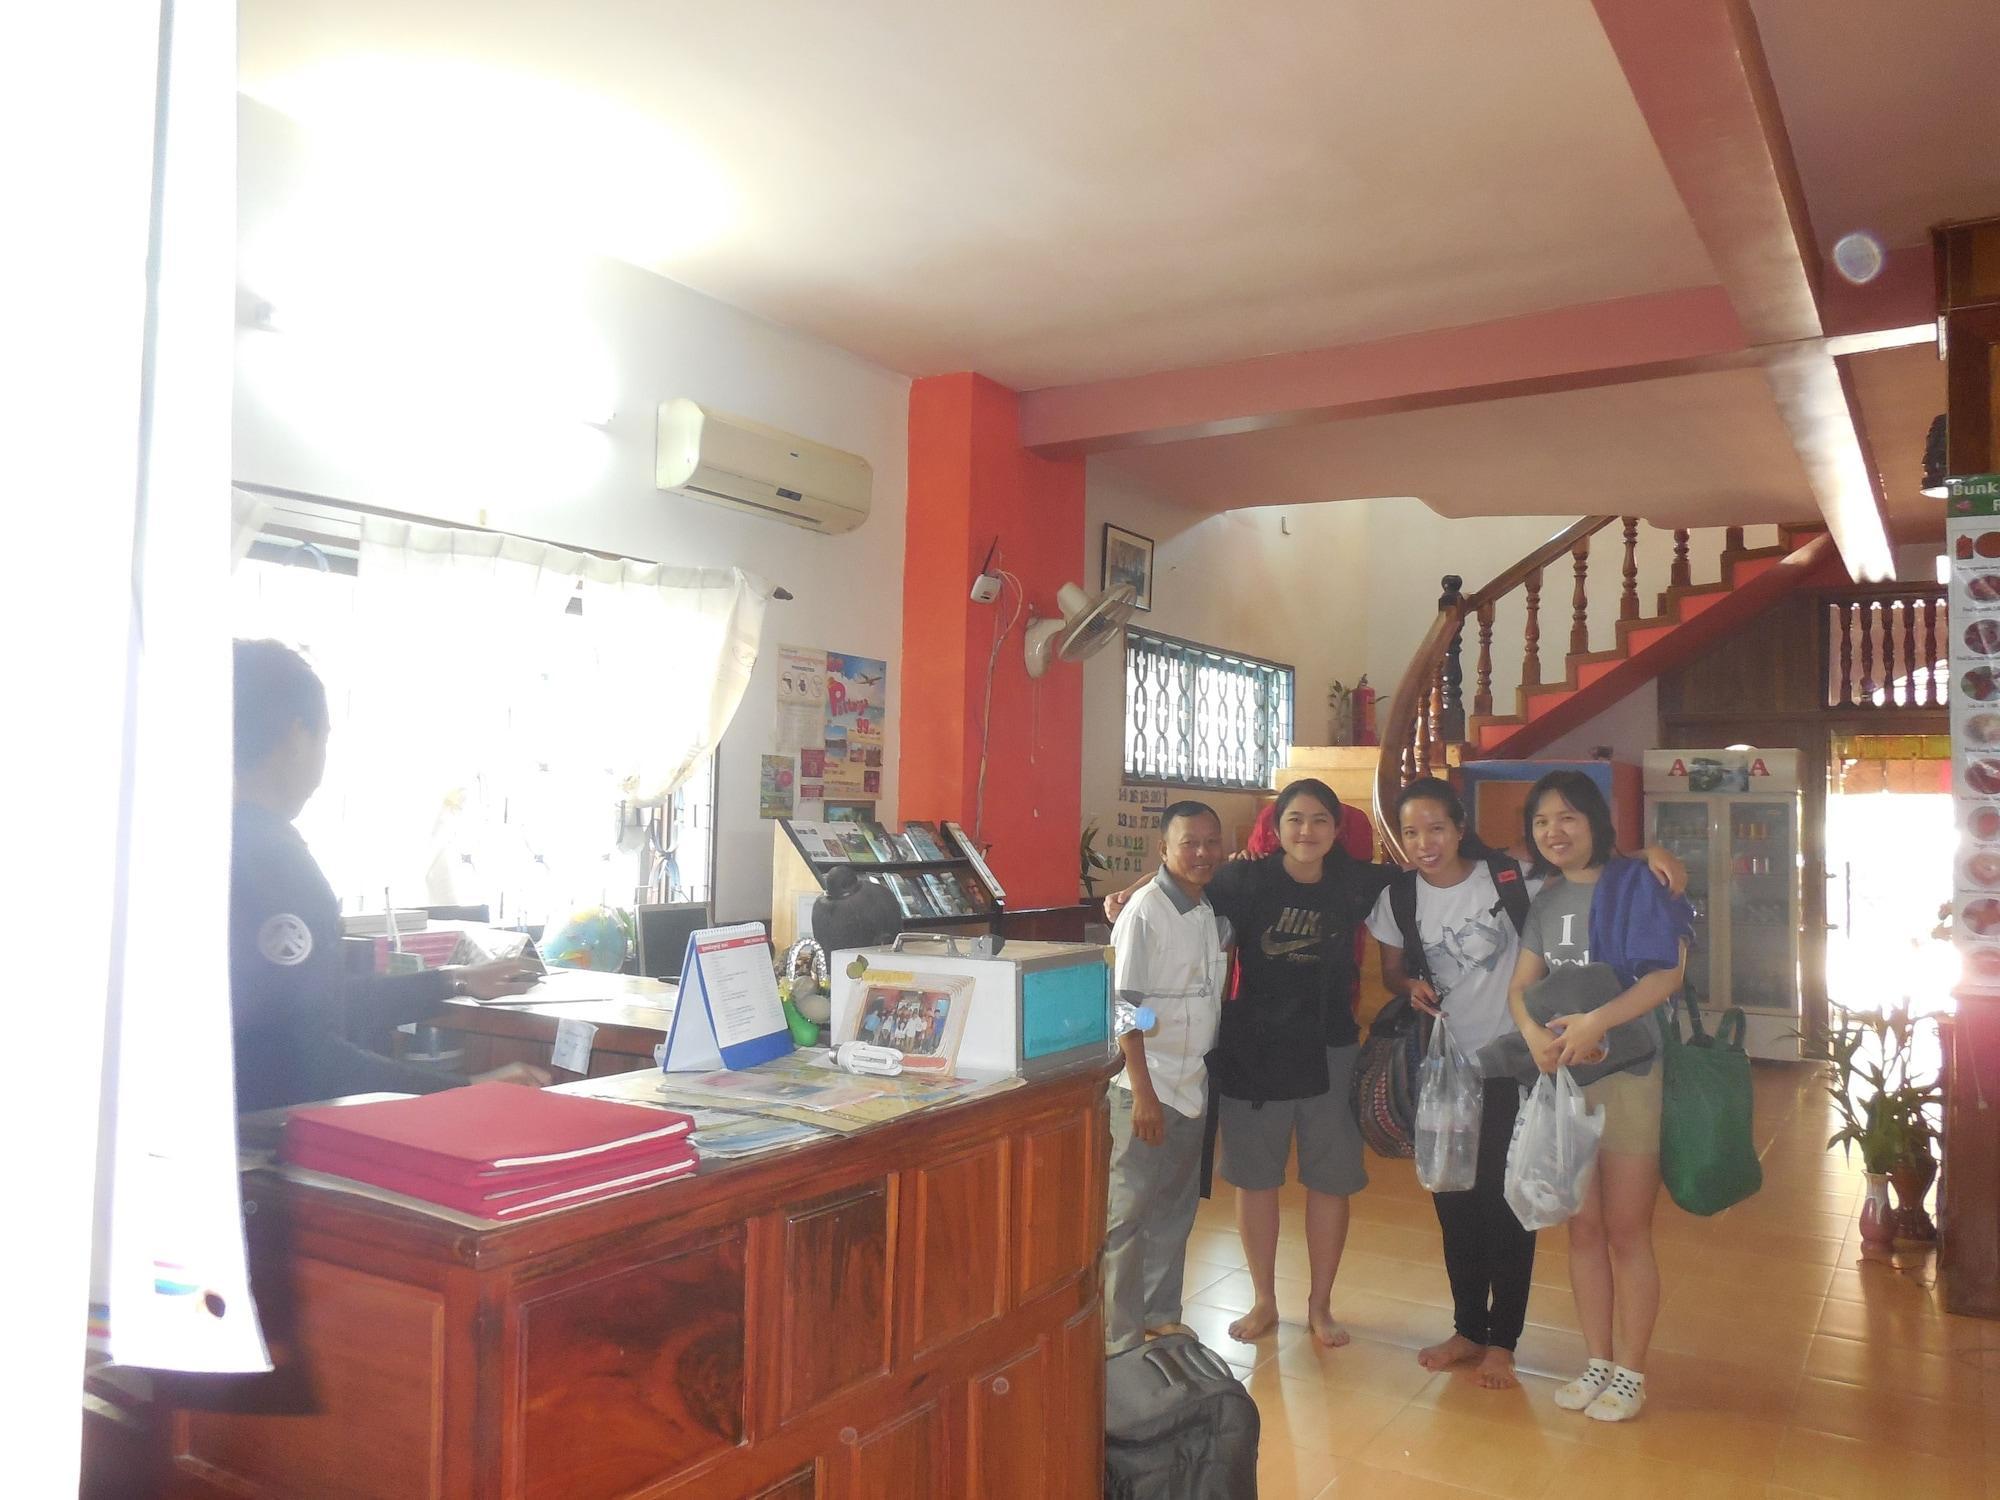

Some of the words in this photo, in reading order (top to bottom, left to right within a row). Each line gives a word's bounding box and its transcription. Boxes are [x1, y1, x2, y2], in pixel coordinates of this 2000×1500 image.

[1668, 758, 1688, 776] A
[1750, 758, 1770, 776] A
[1133, 836, 1143, 850] 12
[1275, 907, 1321, 937] NIK
[1558, 913, 1577, 946] I
